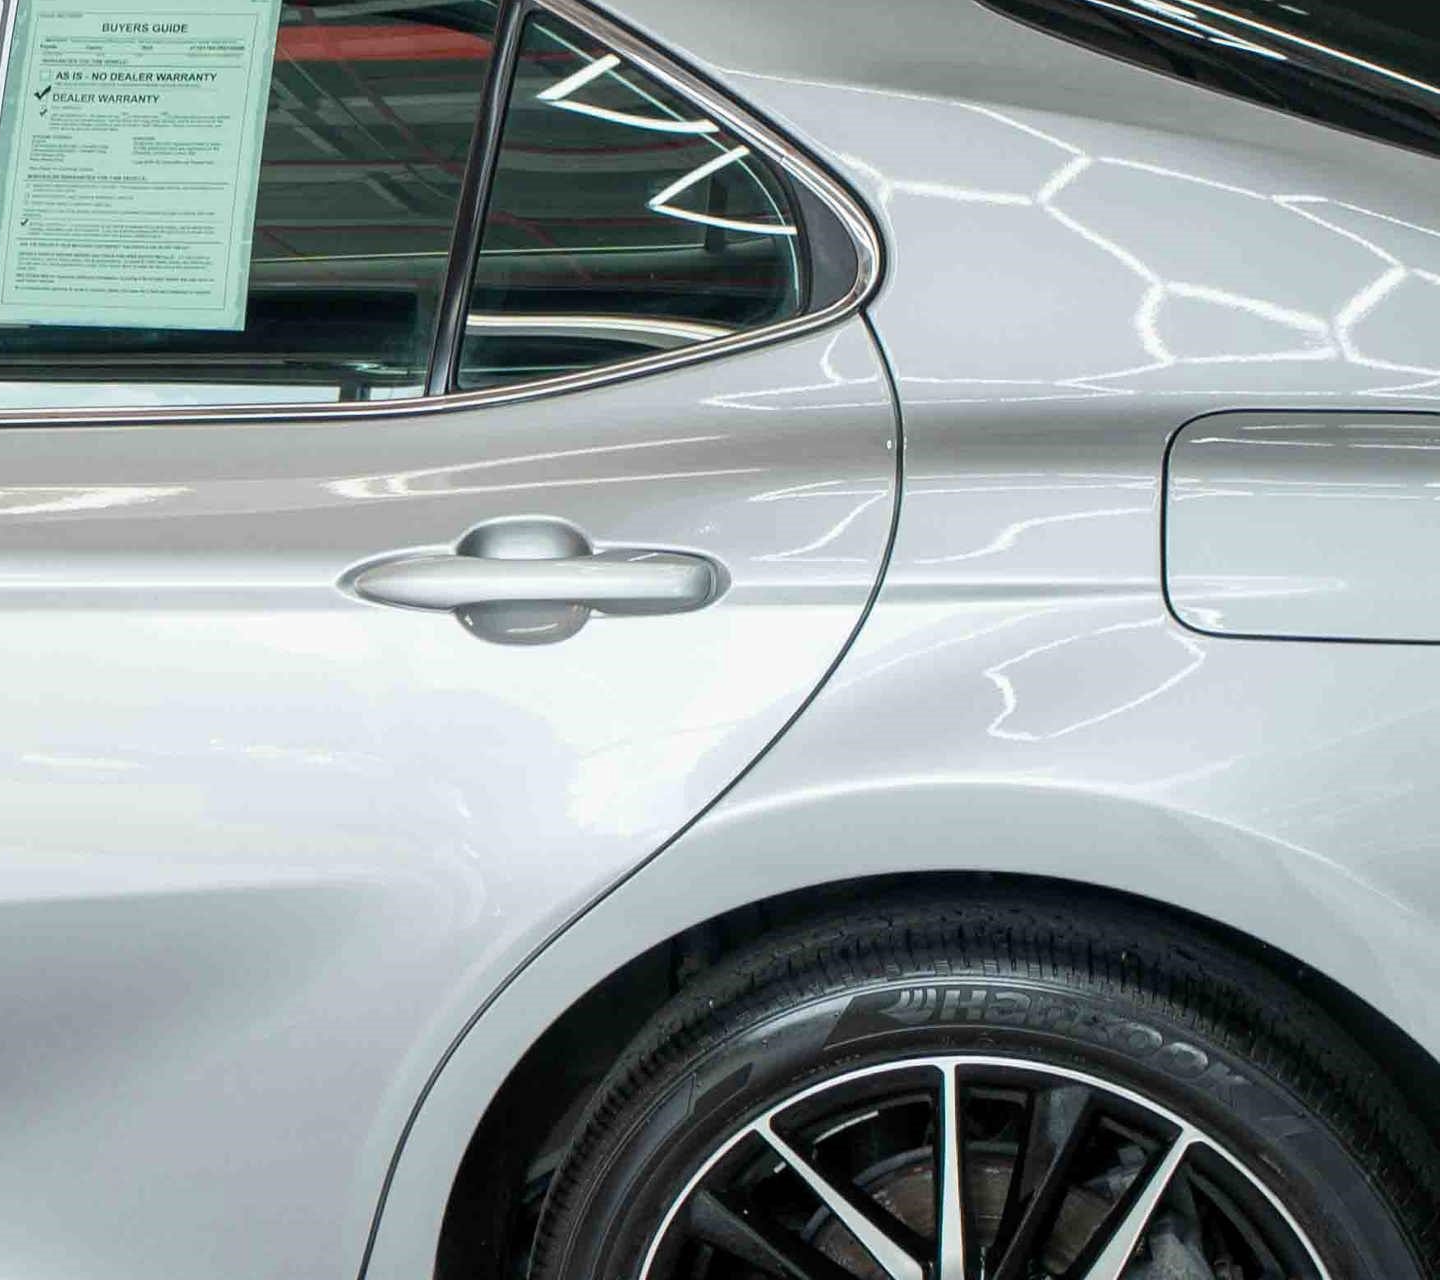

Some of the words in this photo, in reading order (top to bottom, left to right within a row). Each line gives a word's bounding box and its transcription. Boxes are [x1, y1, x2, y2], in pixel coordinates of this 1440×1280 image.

[102, 23, 149, 33] BUYERS
[152, 23, 189, 33] GUIDE
[56, 71, 70, 81] AS
[72, 72, 83, 80] IS
[91, 72, 107, 81] NO
[110, 72, 153, 81] DEALER
[156, 73, 218, 82] WARRANTY
[52, 93, 96, 103] DEALER
[98, 94, 161, 104] WARRANTY
